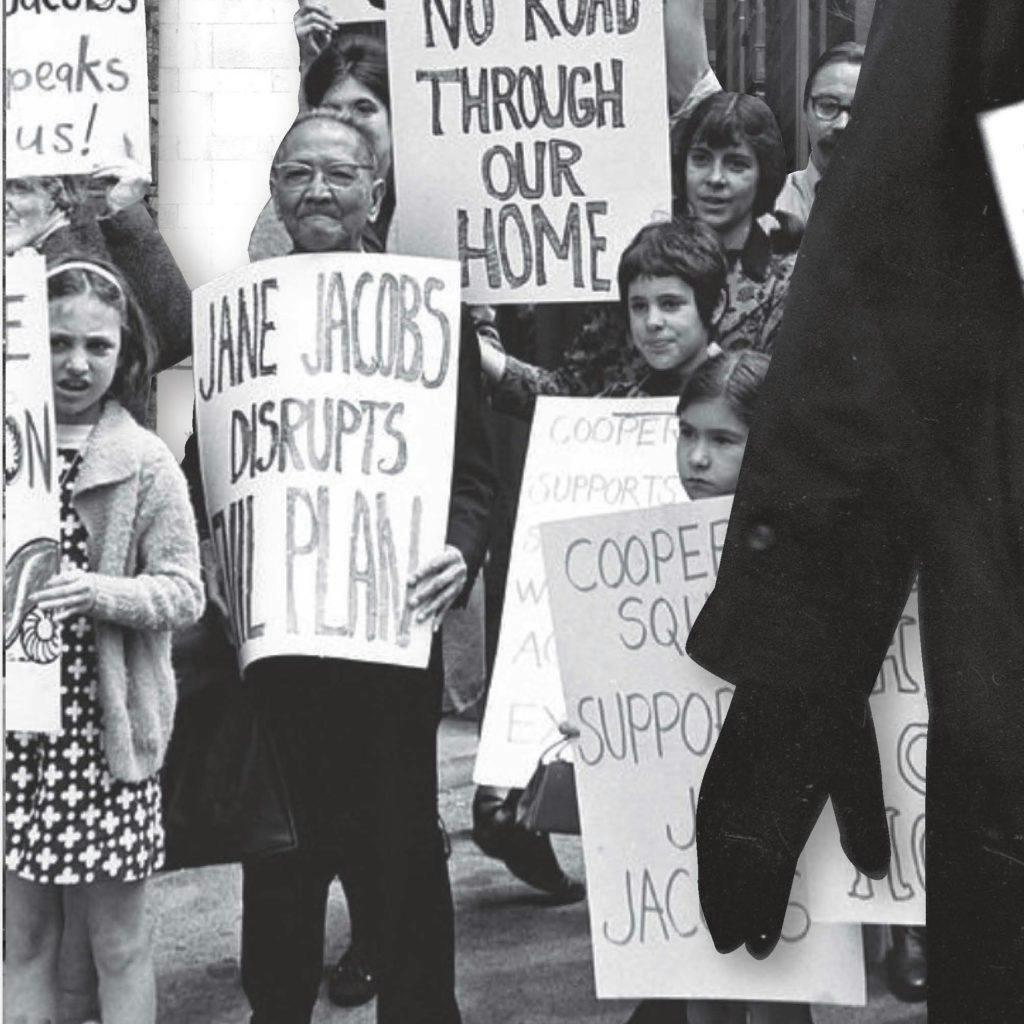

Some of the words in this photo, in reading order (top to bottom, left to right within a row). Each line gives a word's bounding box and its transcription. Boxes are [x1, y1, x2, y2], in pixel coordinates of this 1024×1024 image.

[16, 103, 98, 156] us!
[415, 58, 626, 136] THROUGH
[481, 138, 586, 201] OUR
[457, 201, 612, 292] HOME
[199, 279, 279, 403] JANE
[300, 271, 451, 389] JACOBS
[230, 397, 408, 485] DISRUPTS
[528, 473, 679, 509] SUPPORTS
